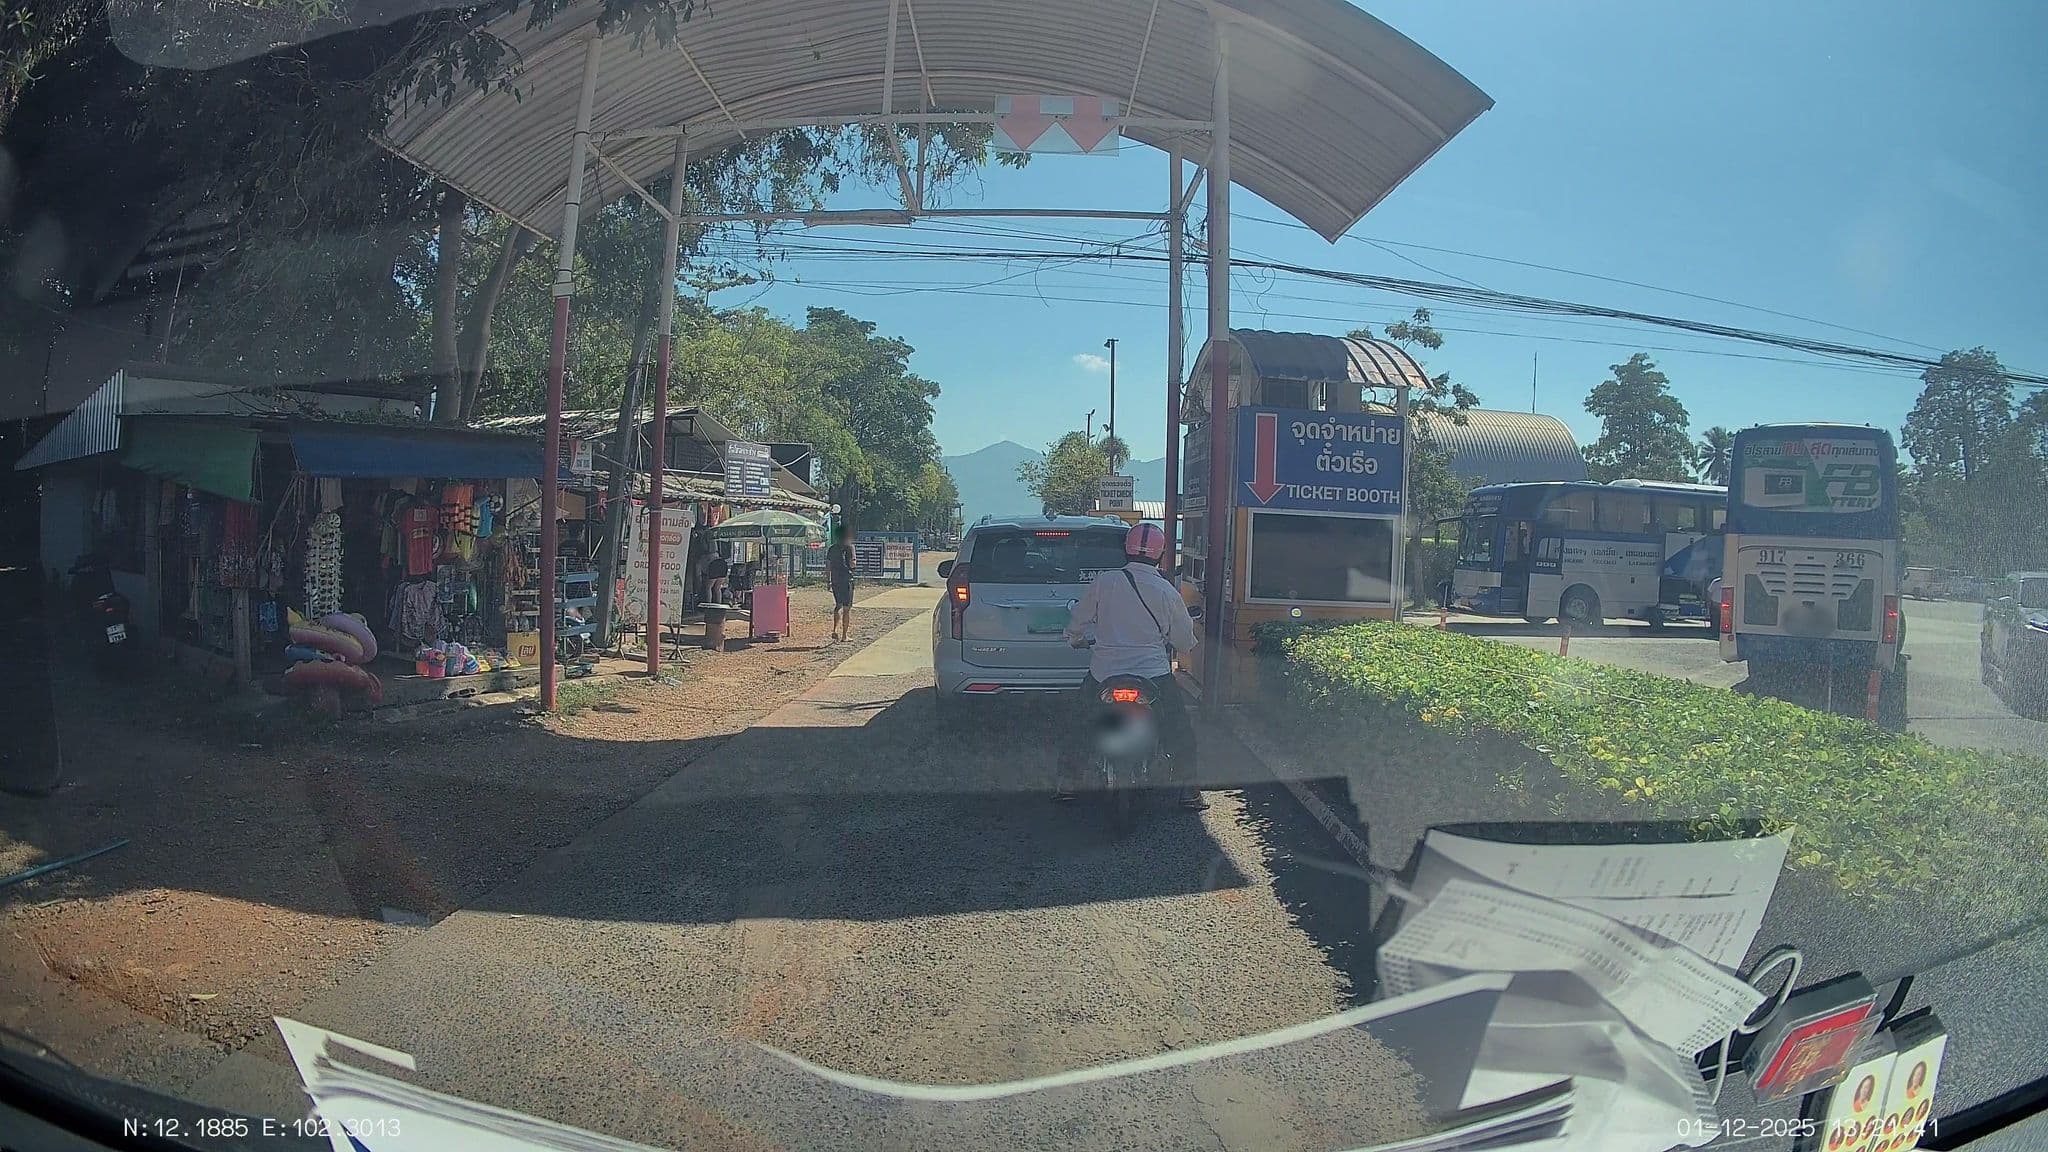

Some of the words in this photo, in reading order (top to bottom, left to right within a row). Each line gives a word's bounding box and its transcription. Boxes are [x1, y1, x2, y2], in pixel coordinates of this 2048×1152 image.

[1290, 416, 1401, 446] จุดจำหน่าย
[1287, 484, 1343, 502] TICKET
[1346, 486, 1401, 505] BOOTH
[1760, 550, 1786, 563] 917
